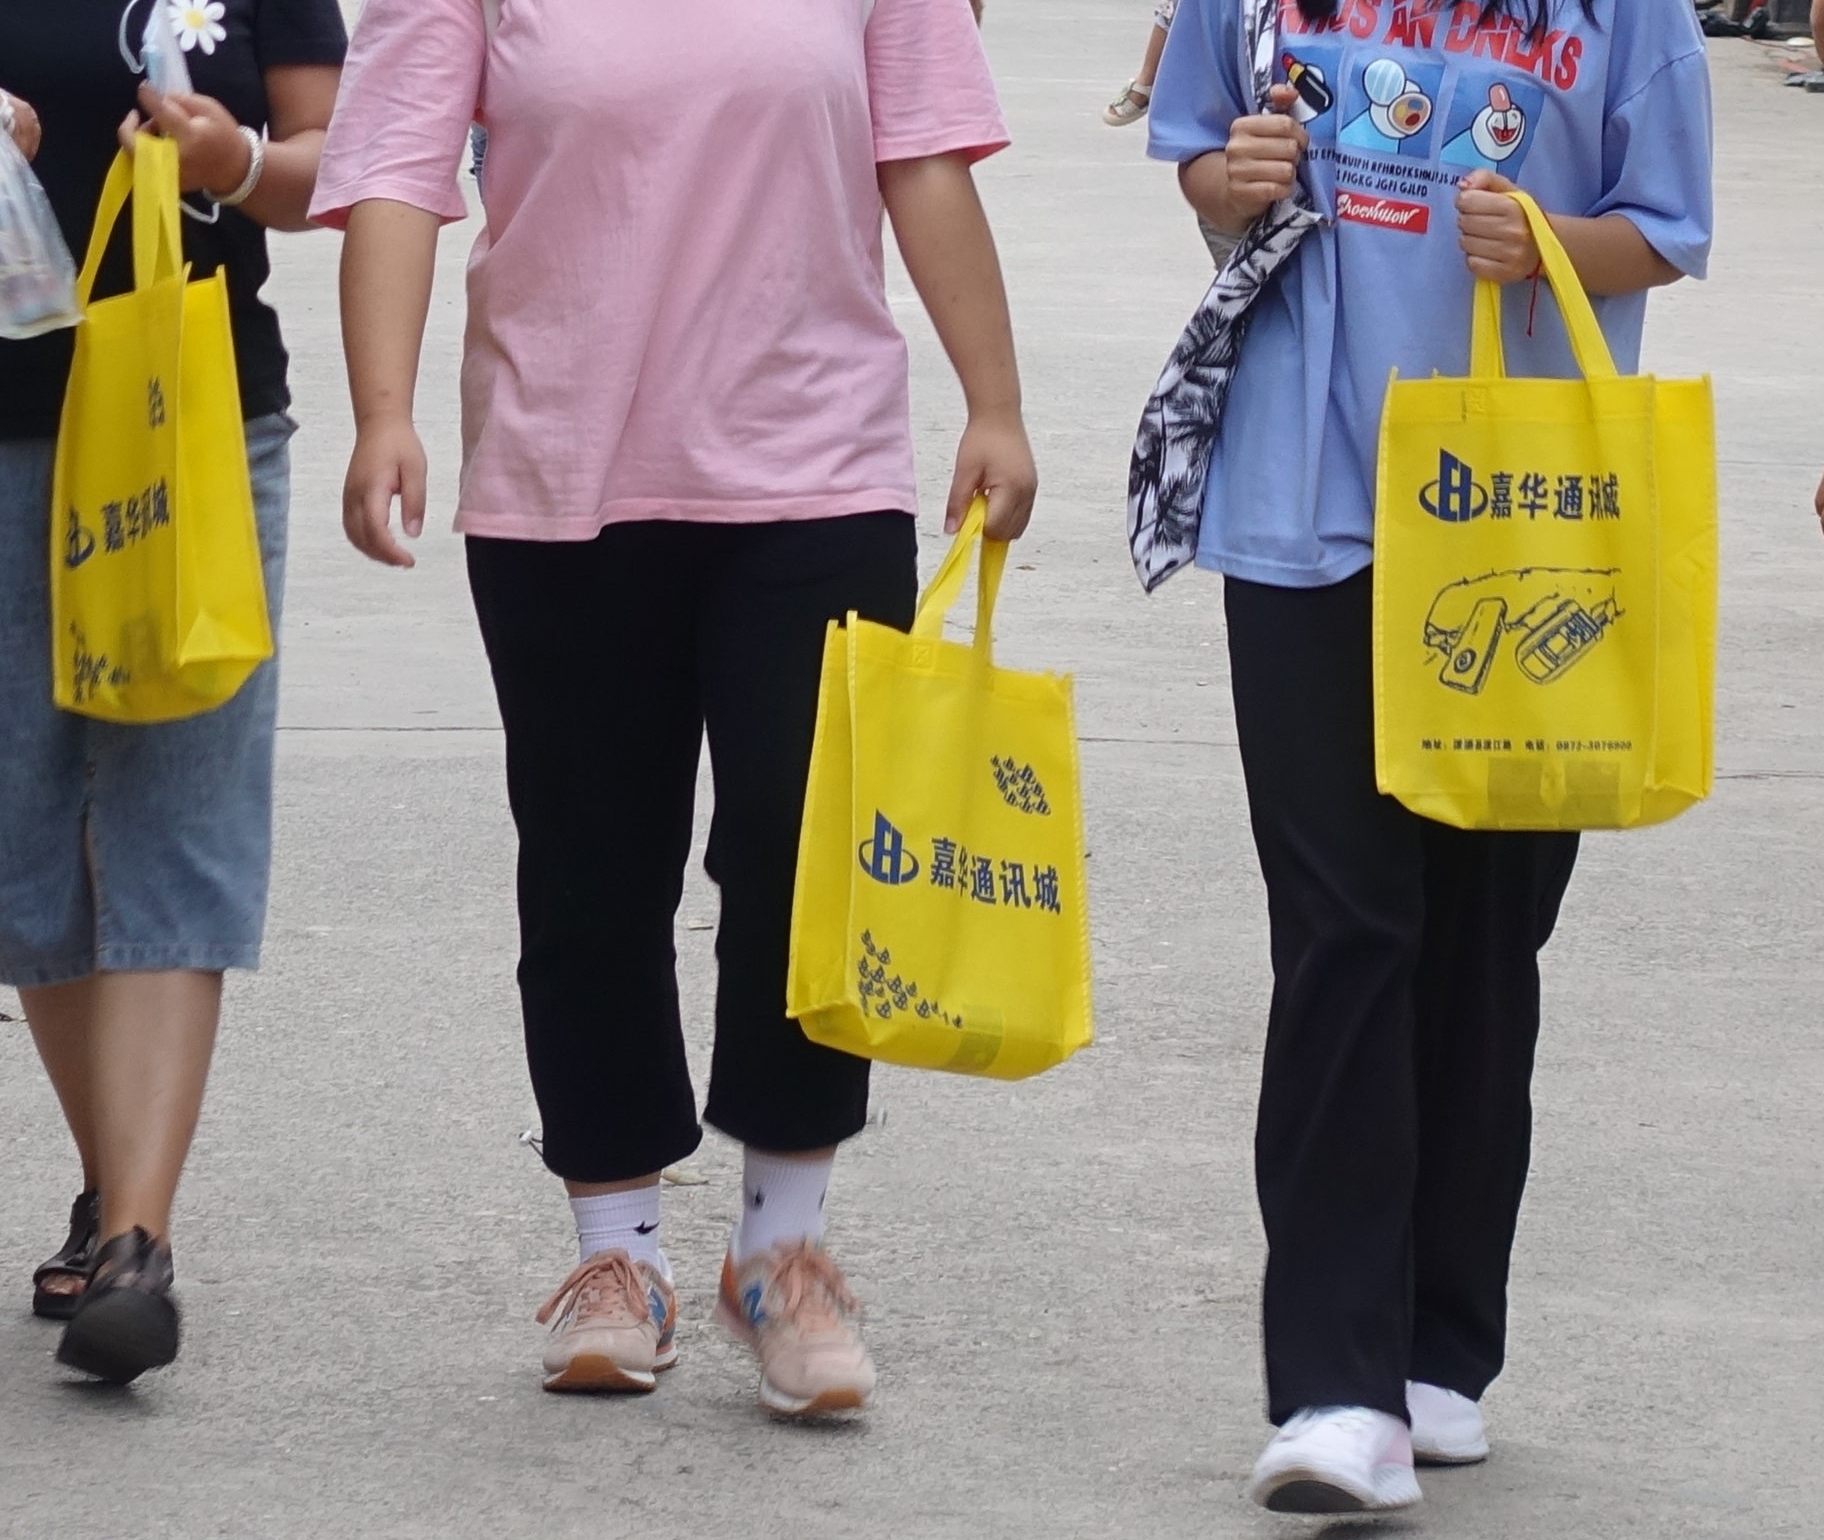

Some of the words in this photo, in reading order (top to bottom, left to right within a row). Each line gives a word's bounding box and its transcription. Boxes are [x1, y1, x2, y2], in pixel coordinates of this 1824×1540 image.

[929, 836, 1062, 916] 嘉华通讯城
